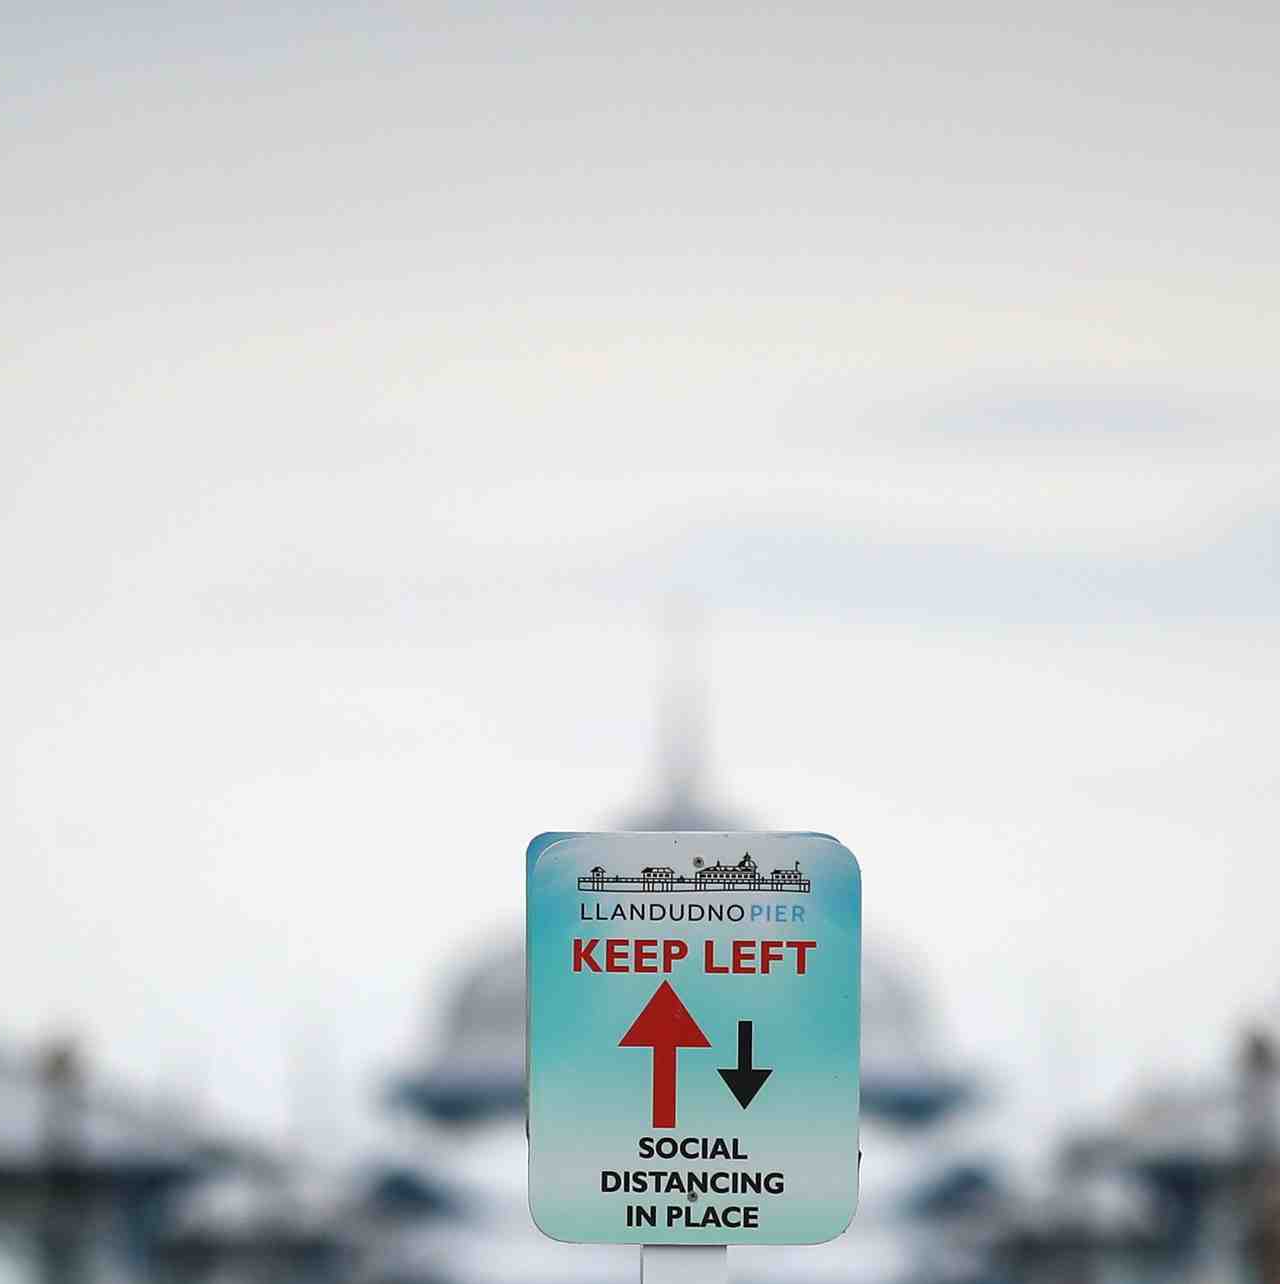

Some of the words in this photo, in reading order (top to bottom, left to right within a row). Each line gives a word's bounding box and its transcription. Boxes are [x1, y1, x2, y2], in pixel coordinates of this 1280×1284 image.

[573, 938, 688, 974] KEEP
[704, 939, 817, 975] LEFT
[638, 1137, 748, 1160] SOCIAL
[600, 1170, 785, 1194] DISTANCING
[626, 1206, 657, 1228] IN
[666, 1206, 759, 1229] PLACE
